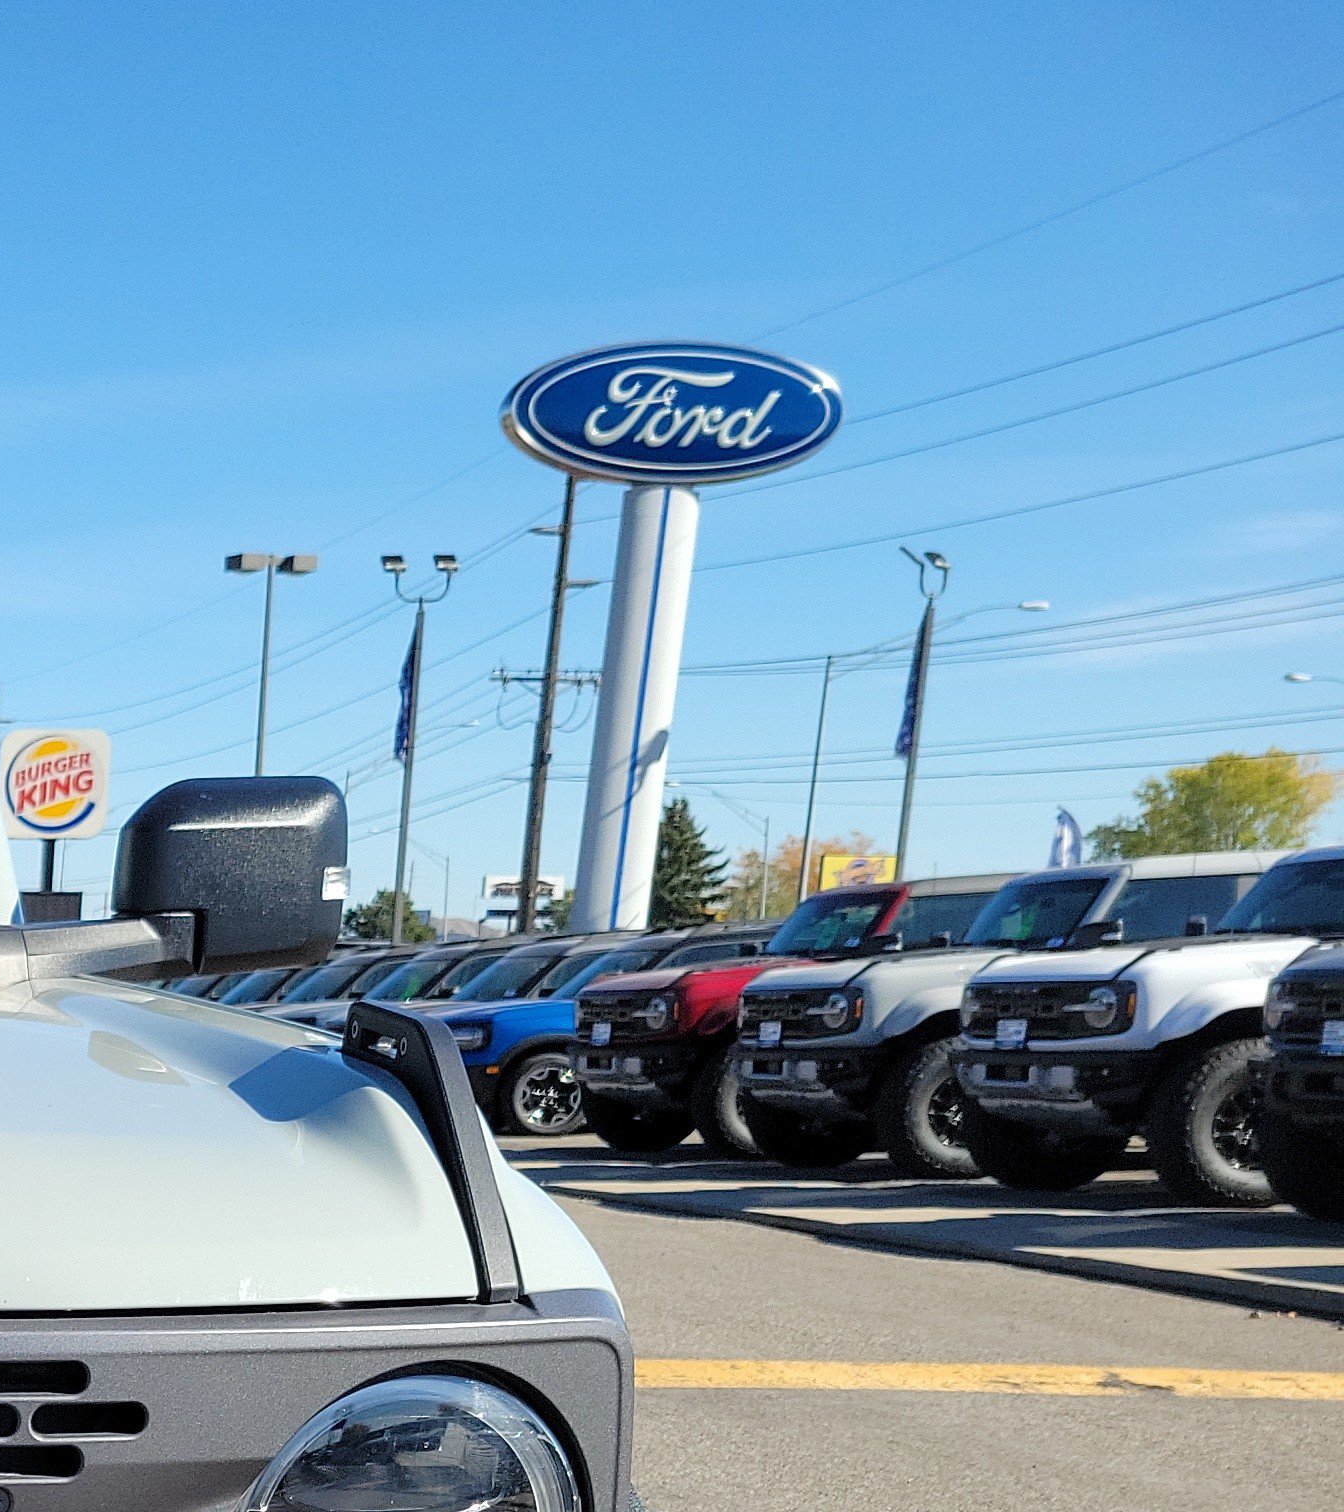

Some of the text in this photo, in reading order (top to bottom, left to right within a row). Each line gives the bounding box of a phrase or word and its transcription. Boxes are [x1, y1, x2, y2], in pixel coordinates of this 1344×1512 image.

[584, 365, 782, 449] Ford
[15, 752, 91, 788] BURGER
[16, 769, 94, 815] KING
